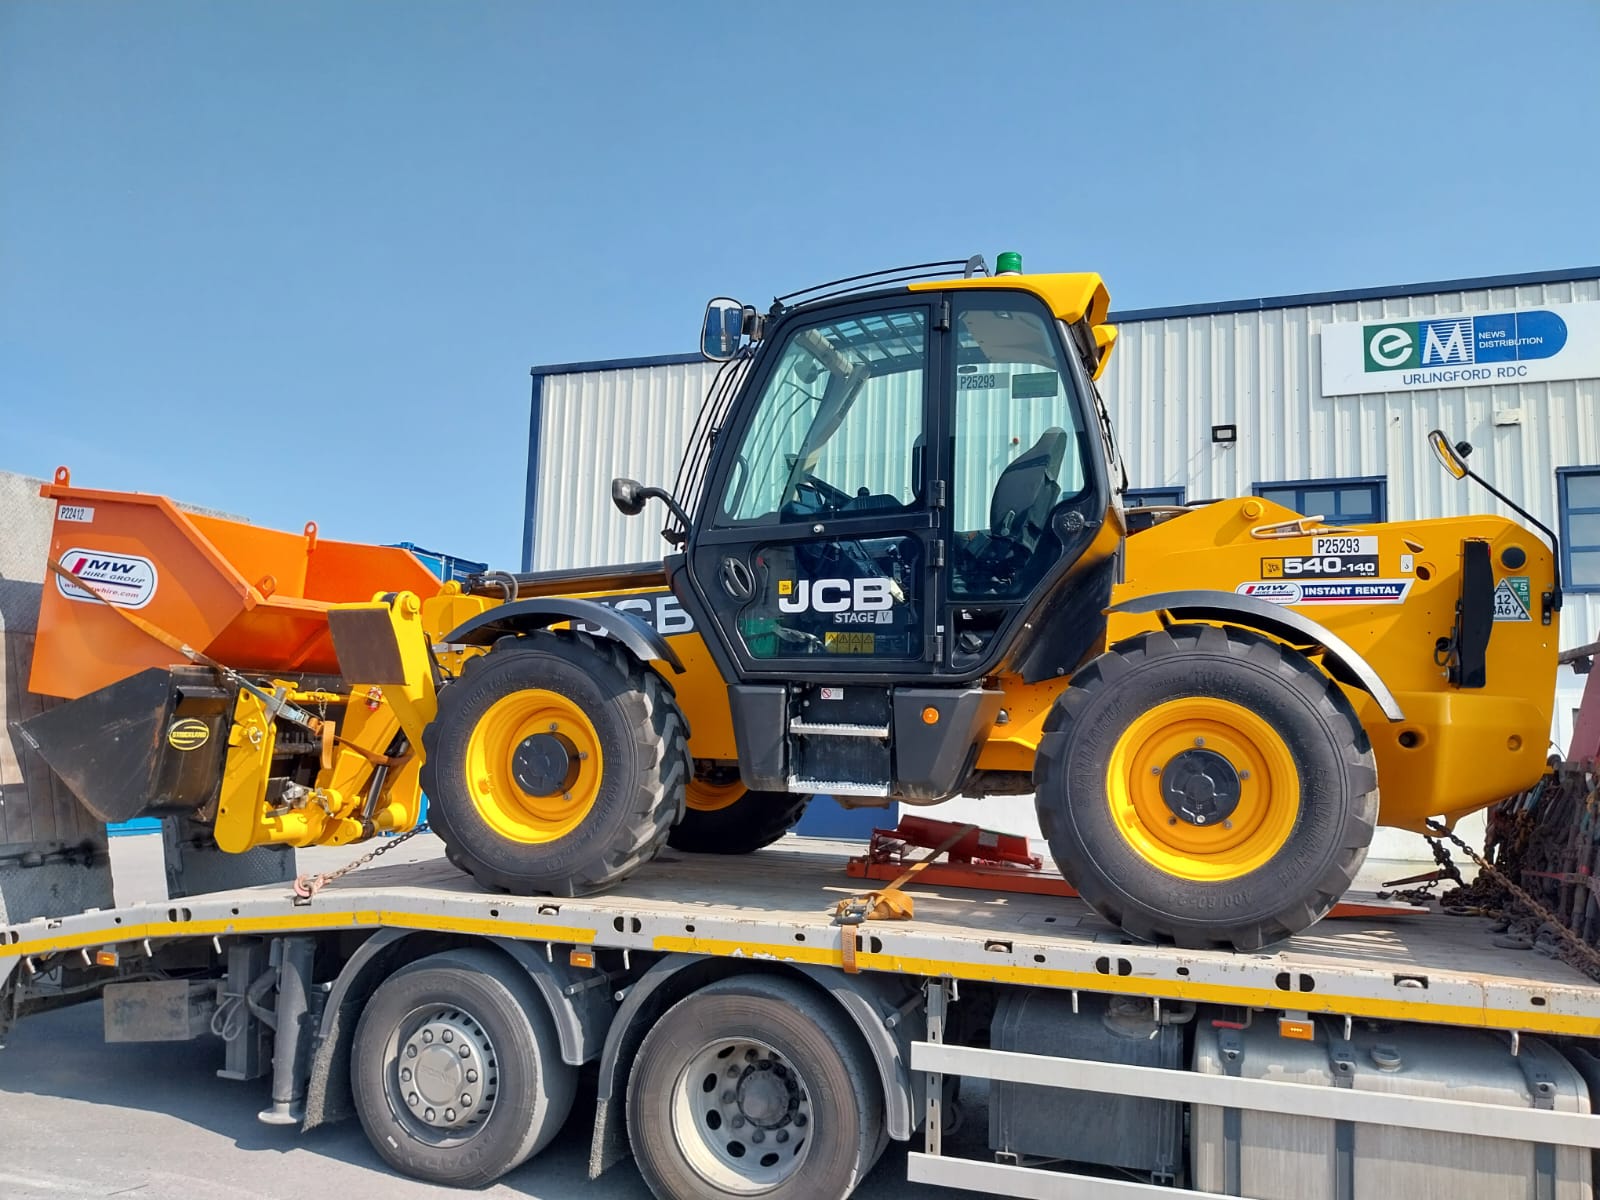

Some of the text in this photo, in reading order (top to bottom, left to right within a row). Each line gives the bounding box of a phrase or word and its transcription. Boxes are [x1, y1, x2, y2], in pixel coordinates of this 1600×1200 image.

[1478, 330, 1506, 340] NEWS
[1479, 336, 1543, 349] DISTRIBUTION
[1402, 365, 1528, 385] URLINGFORD RDC
[960, 374, 995, 390] P25293
[60, 507, 85, 520] P22412
[1317, 538, 1360, 554] P25293
[88, 560, 136, 574] MW
[1283, 557, 1375, 574] 540-140
[82, 570, 146, 584] HIRE GROUP
[1304, 586, 1399, 595] INSTANT RENTAL
[1520, 583, 1528, 591] 5
[778, 577, 894, 613] JCB
[1497, 594, 1511, 605] 12
[834, 612, 875, 624] STAGE
